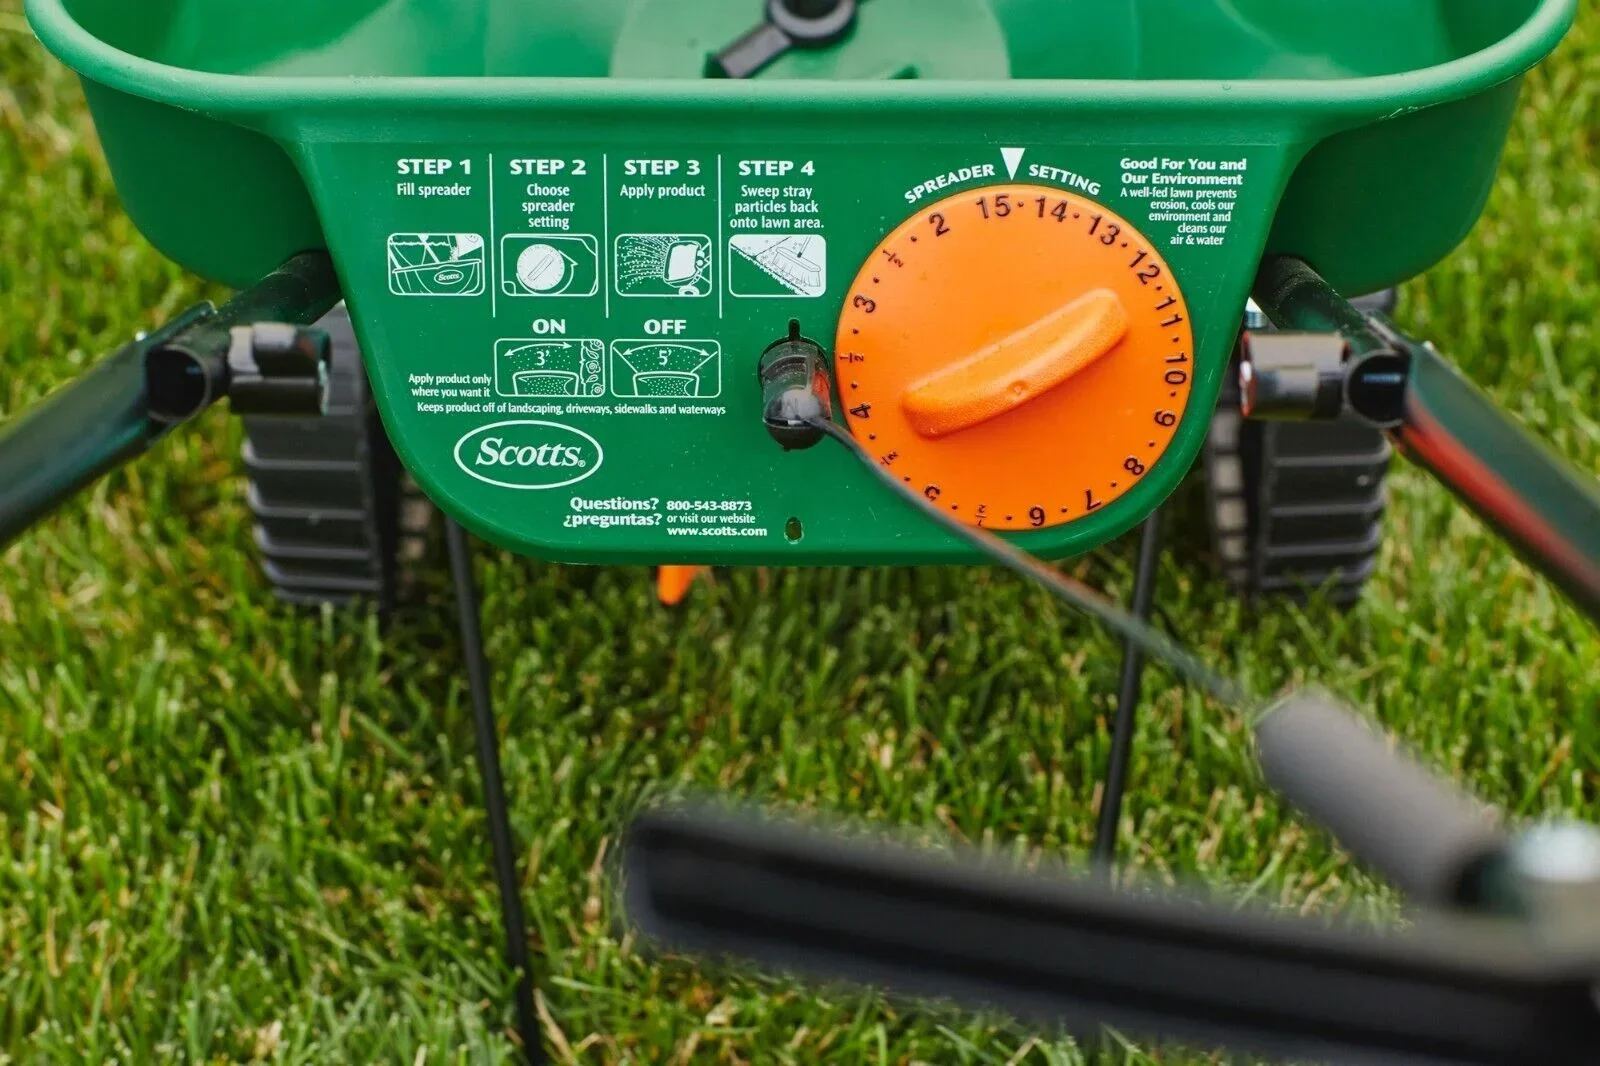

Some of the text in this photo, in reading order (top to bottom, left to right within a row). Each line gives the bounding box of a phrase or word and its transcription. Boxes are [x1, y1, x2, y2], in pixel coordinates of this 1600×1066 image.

[397, 159, 470, 174] STEP 1
[510, 159, 587, 175] STEP 2
[624, 160, 700, 175] STEP 3
[739, 160, 815, 175] STEP 4
[1120, 158, 1246, 170] Good For You and
[904, 163, 1101, 203] SPREADER SETTING
[1122, 173, 1243, 185] Our Environment
[397, 183, 471, 198] Fill spreader
[527, 183, 569, 196] Choose
[620, 184, 706, 198] Apply product
[742, 185, 812, 199] Sweep stray
[1120, 187, 1238, 200] A well-fed lawn prevents
[522, 199, 575, 214] spreader
[735, 200, 818, 214] particles back
[976, 194, 1012, 220] 15
[1035, 196, 1068, 223] 14
[1150, 199, 1235, 211] erosion, cools our
[529, 215, 569, 230] setting
[729, 216, 825, 229] onto lawn area.
[1148, 211, 1231, 222] environment and
[929, 212, 951, 237] 2
[1087, 213, 1120, 245] 13
[1177, 223, 1227, 233] cleans our
[1170, 234, 1224, 245] air & water
[1128, 249, 1161, 284] 12
[852, 294, 877, 314] 3
[1154, 296, 1182, 328] 11
[533, 319, 565, 334] ON
[644, 319, 686, 334] OFF
[1164, 352, 1188, 385] 10
[408, 373, 492, 386] Apply product only
[411, 387, 491, 399] where you want it
[417, 402, 725, 416] Keeps product off of landscaping, driveways, sidewalks and waterways
[849, 403, 871, 419] 4
[1153, 411, 1176, 427] 9
[1123, 458, 1145, 476] 8
[570, 497, 659, 512] Questions?
[667, 501, 752, 510] 800-543-8873
[1085, 490, 1101, 510] 7
[564, 511, 662, 528] ¿preguntas?
[679, 513, 698, 523] visit
[720, 513, 755, 523] website
[1029, 506, 1046, 526] 6
[667, 527, 767, 536] www.scotts.com
